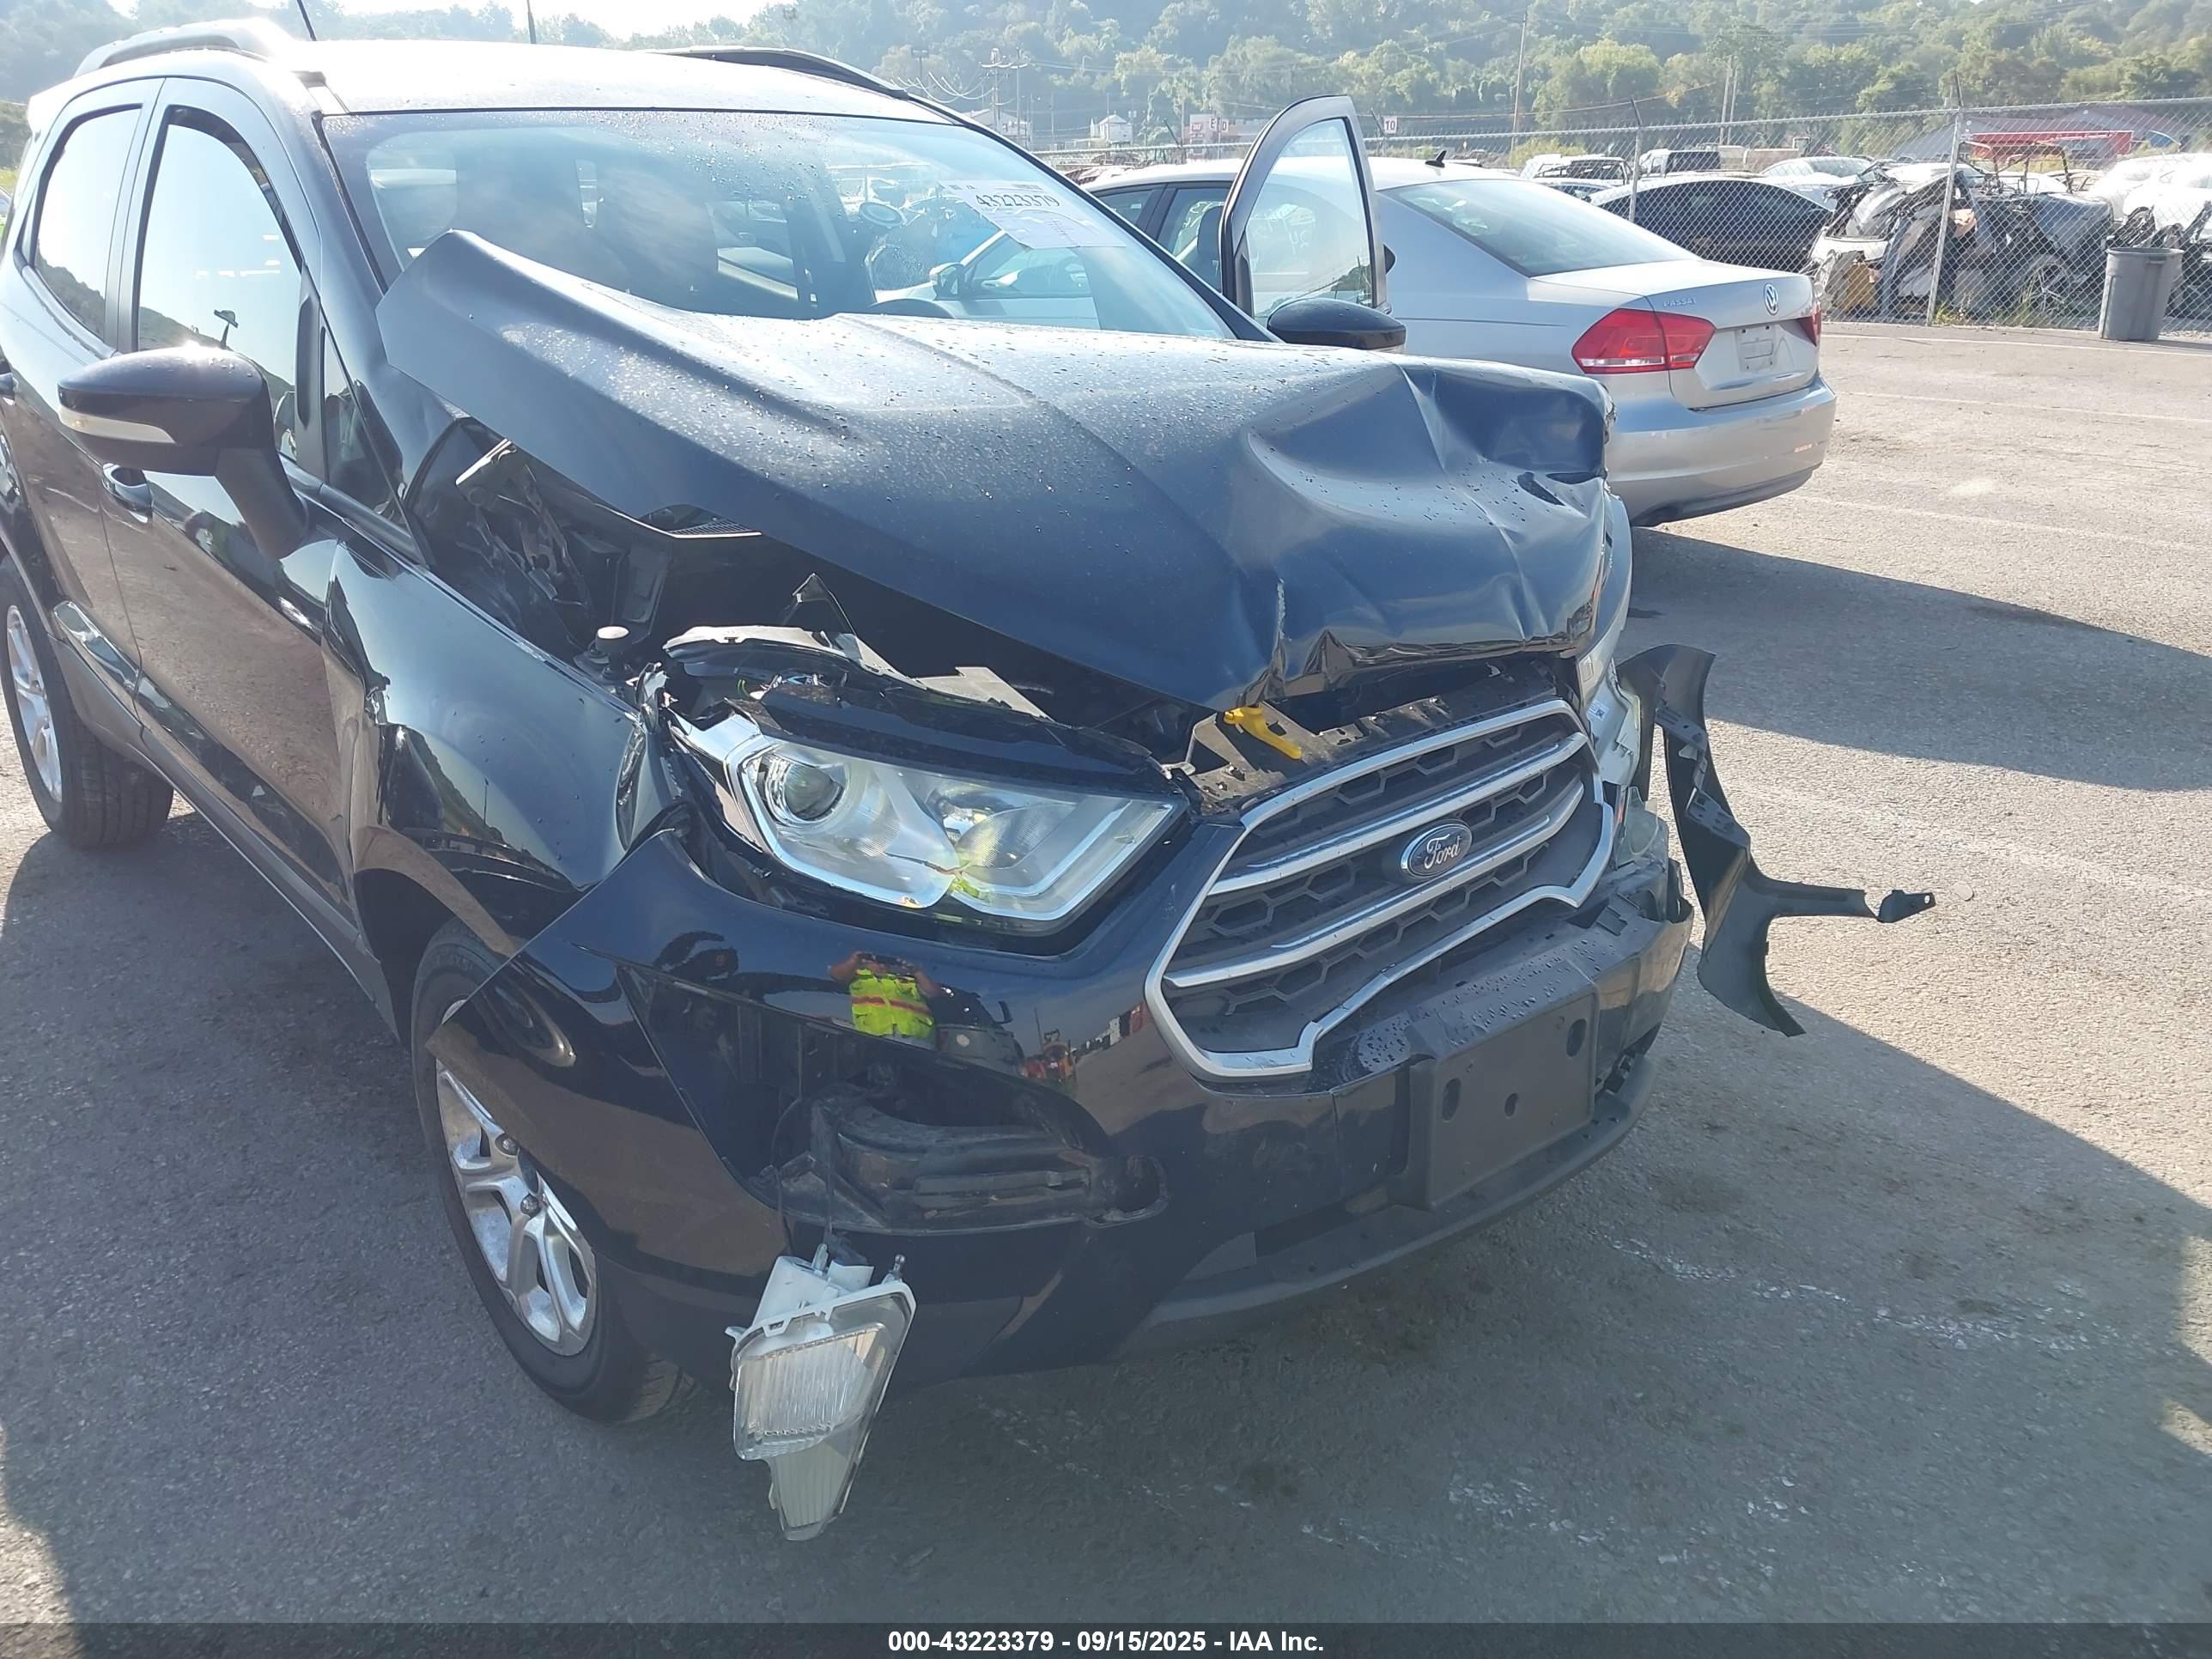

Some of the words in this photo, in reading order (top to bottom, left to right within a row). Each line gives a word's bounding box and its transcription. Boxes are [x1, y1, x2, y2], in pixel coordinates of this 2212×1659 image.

[1385, 120, 1395, 131] 10
[975, 194, 1060, 207] 43223379
[1424, 833, 1462, 870] Ford
